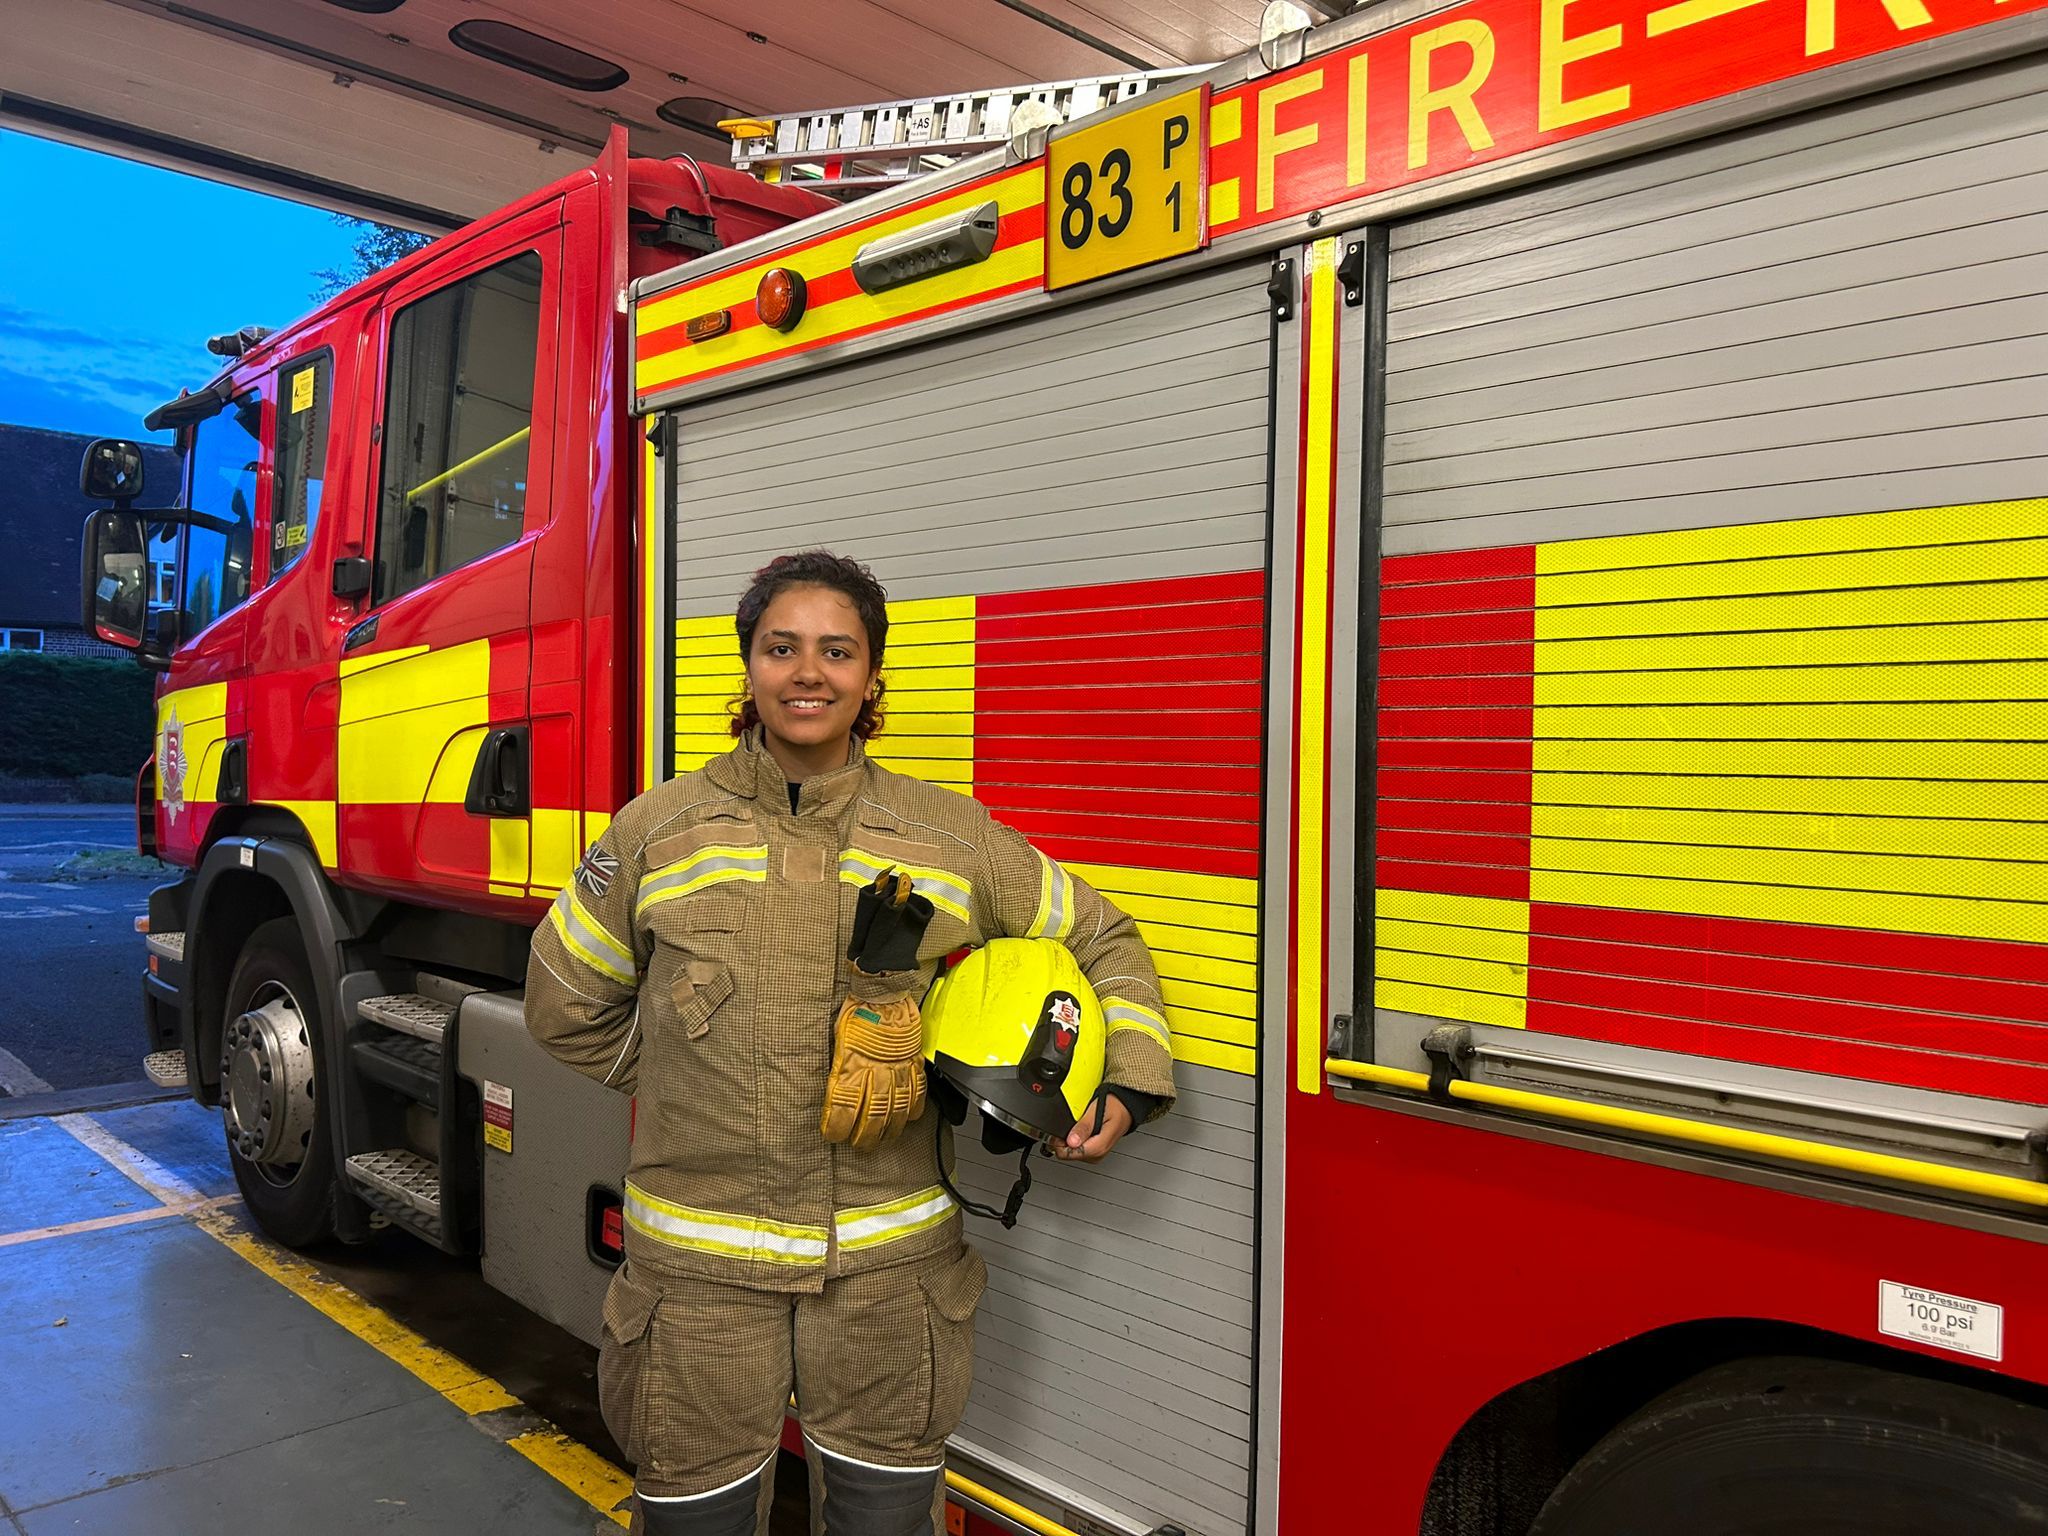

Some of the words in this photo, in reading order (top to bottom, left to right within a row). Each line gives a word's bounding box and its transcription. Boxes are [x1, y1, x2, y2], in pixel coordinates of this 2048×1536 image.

[1256, 0, 1631, 213] FIRE
[1163, 115, 1189, 170] P
[1060, 148, 1133, 250] 83
[1165, 181, 1181, 233] 1
[1901, 1287, 1926, 1299] Tyre
[1928, 1293, 1978, 1312] Pressure
[1907, 1302, 1940, 1323] 100
[1946, 1314, 1973, 1330] psi
